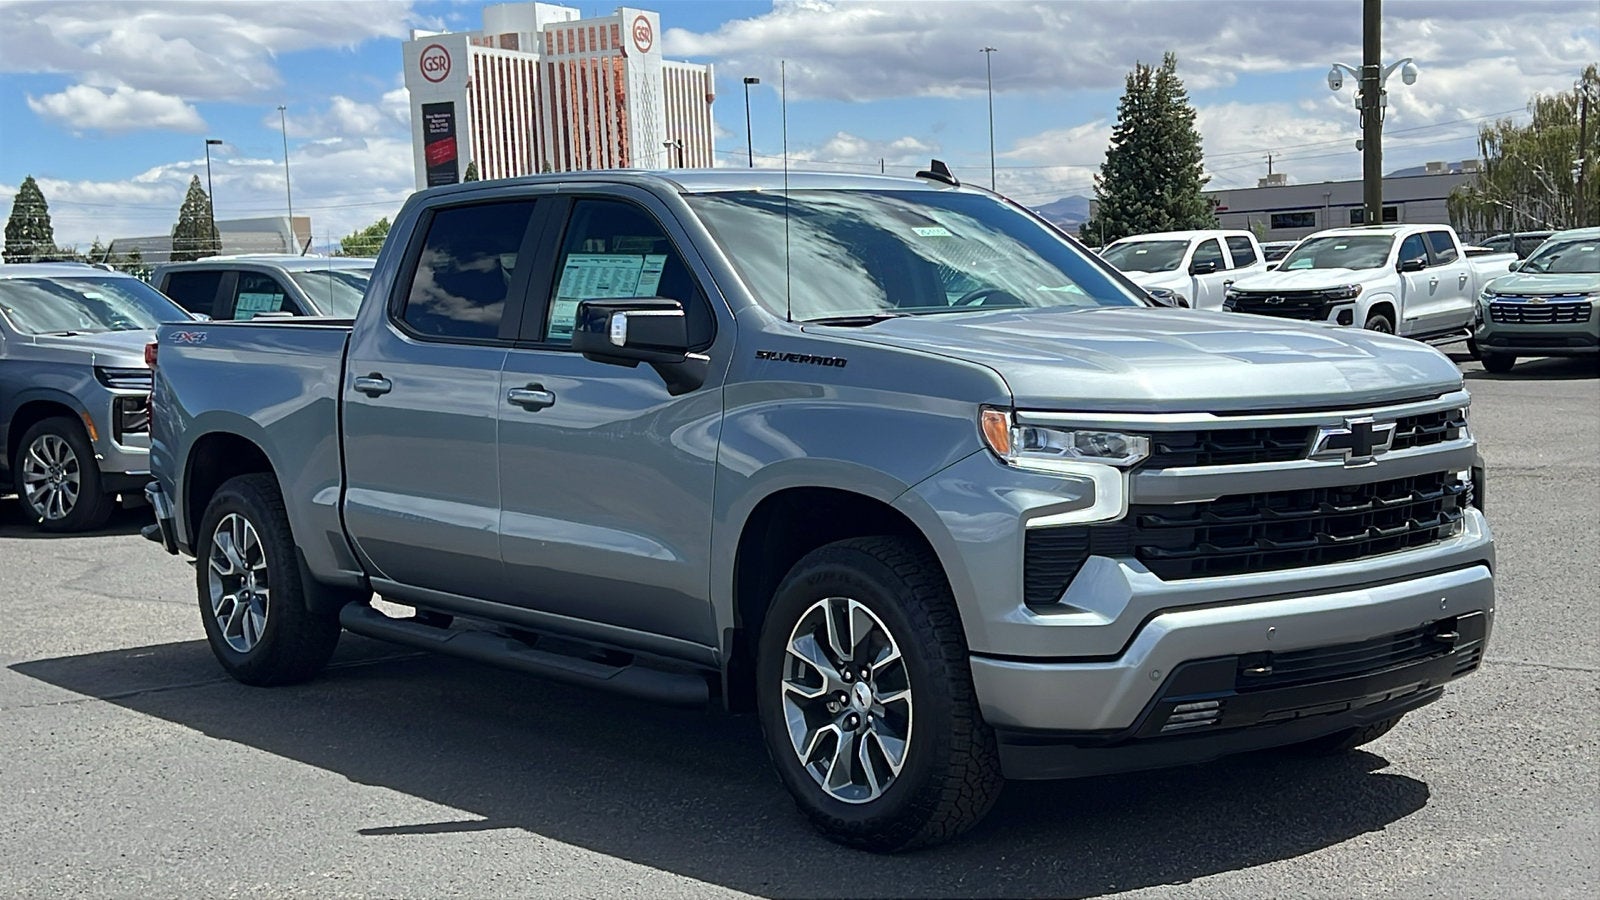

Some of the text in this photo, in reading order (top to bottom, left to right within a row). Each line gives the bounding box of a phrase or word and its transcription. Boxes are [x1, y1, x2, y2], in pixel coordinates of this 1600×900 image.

[636, 25, 650, 43] GSR
[424, 55, 447, 72] GSR
[755, 350, 848, 368] SILVERADO
